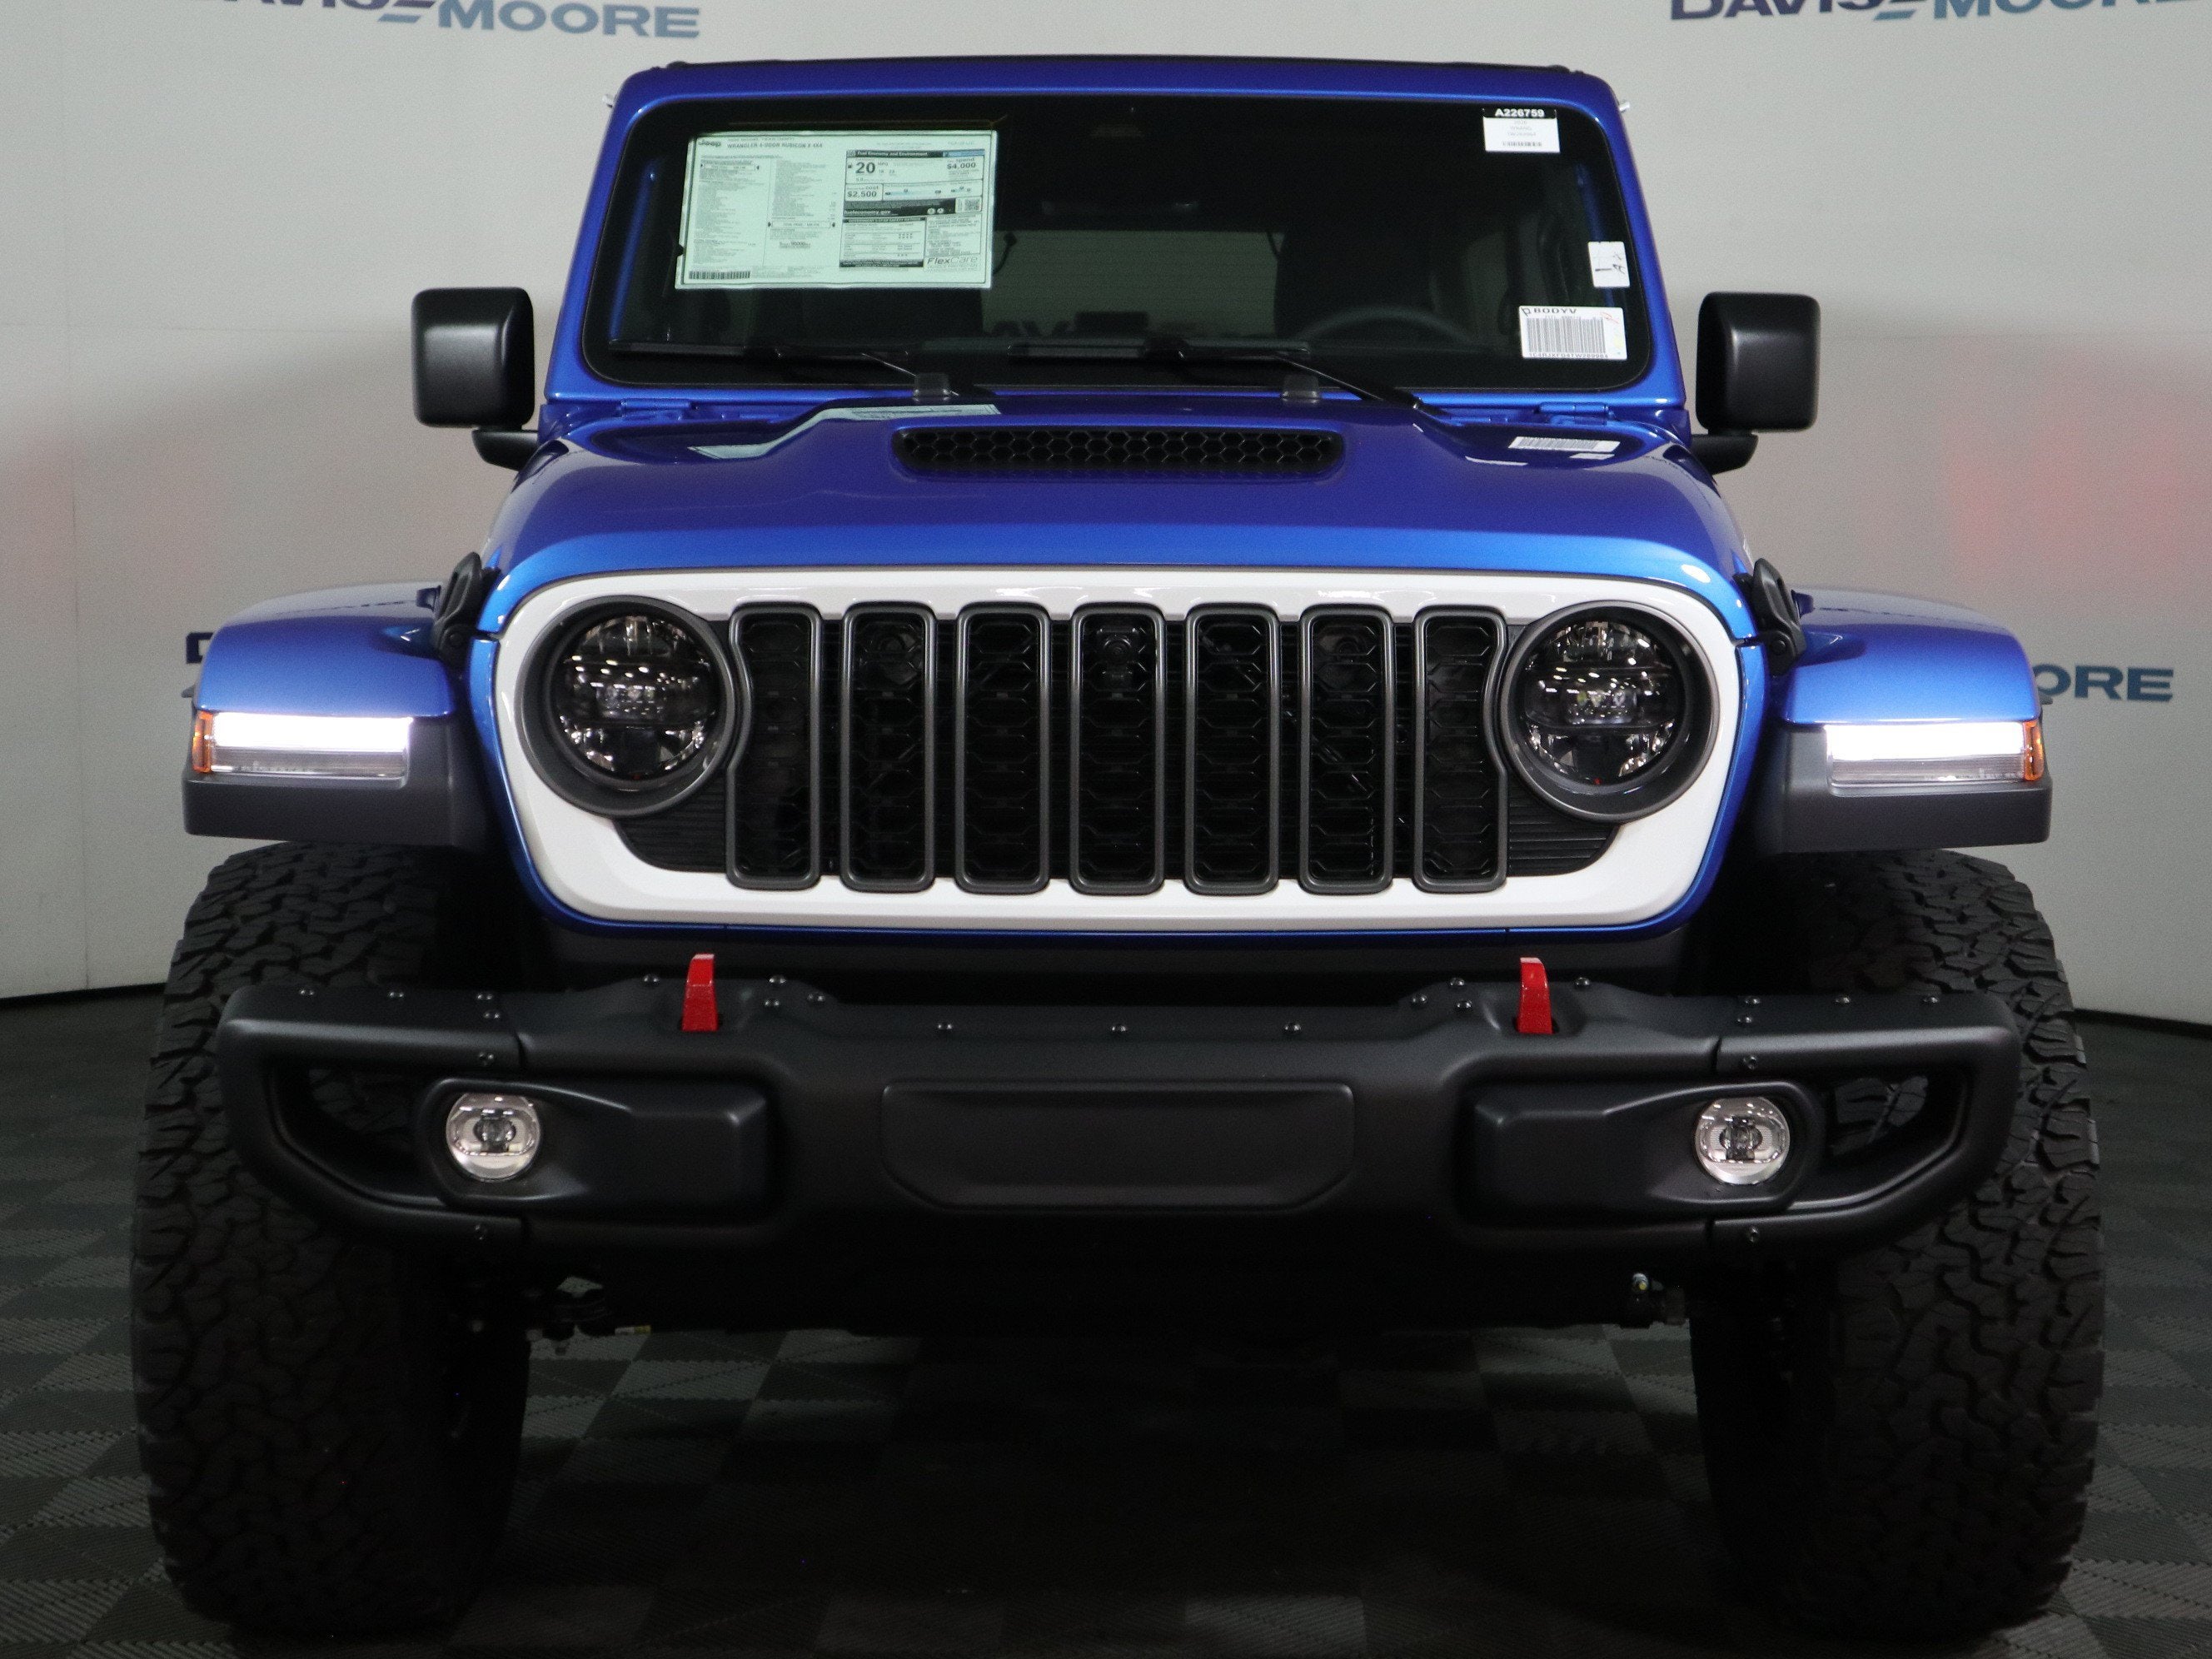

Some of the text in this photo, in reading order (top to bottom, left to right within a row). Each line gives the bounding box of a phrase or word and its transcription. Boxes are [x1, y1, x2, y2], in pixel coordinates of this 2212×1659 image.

[438, 0, 700, 38] MOORE
[1494, 107, 1546, 117] A226759
[698, 139, 722, 147] Jeep
[855, 162, 875, 173] 20
[928, 257, 978, 265] FlexCare
[2032, 664, 2174, 702] ORE
